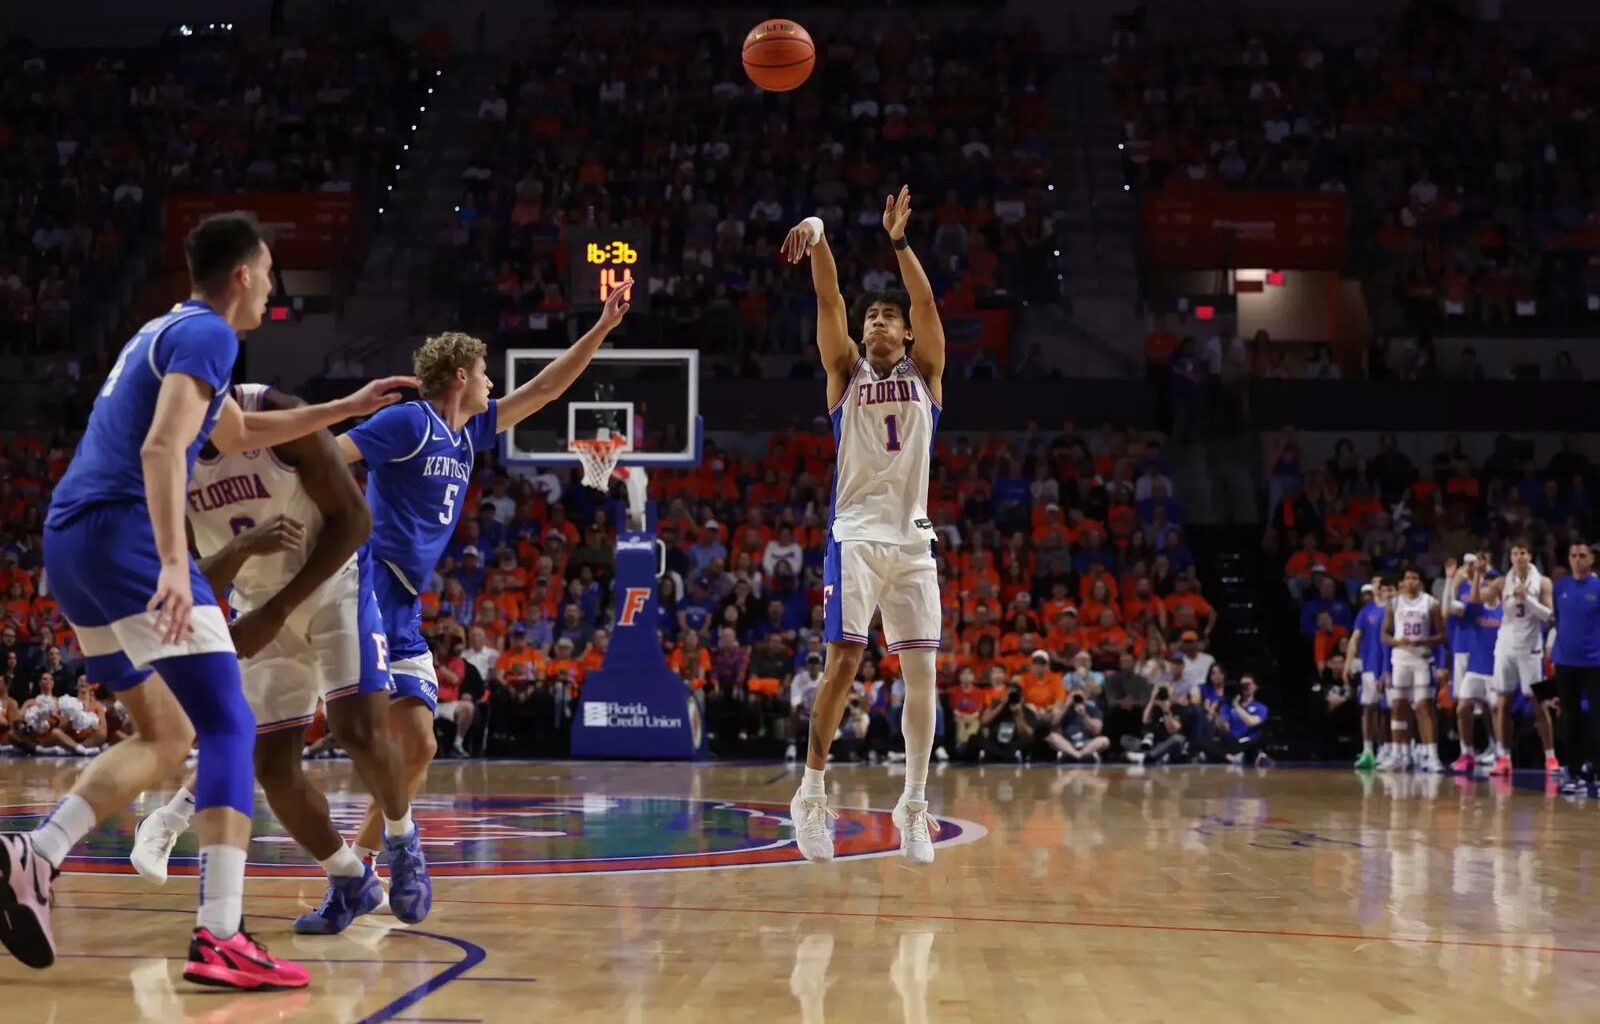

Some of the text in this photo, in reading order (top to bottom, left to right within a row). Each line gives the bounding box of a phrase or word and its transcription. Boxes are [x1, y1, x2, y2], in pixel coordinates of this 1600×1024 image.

[587, 241, 637, 264] 16:36
[600, 268, 631, 302] 14
[857, 380, 921, 407] FLORDA
[884, 414, 901, 452] 1
[187, 473, 272, 513] FLORIDA
[439, 484, 460, 525] 5
[617, 587, 652, 626] F
[1515, 604, 1525, 618] 3
[1403, 622, 1421, 636] 20
[608, 702, 648, 716] Florida
[608, 715, 682, 728] Credit Union
